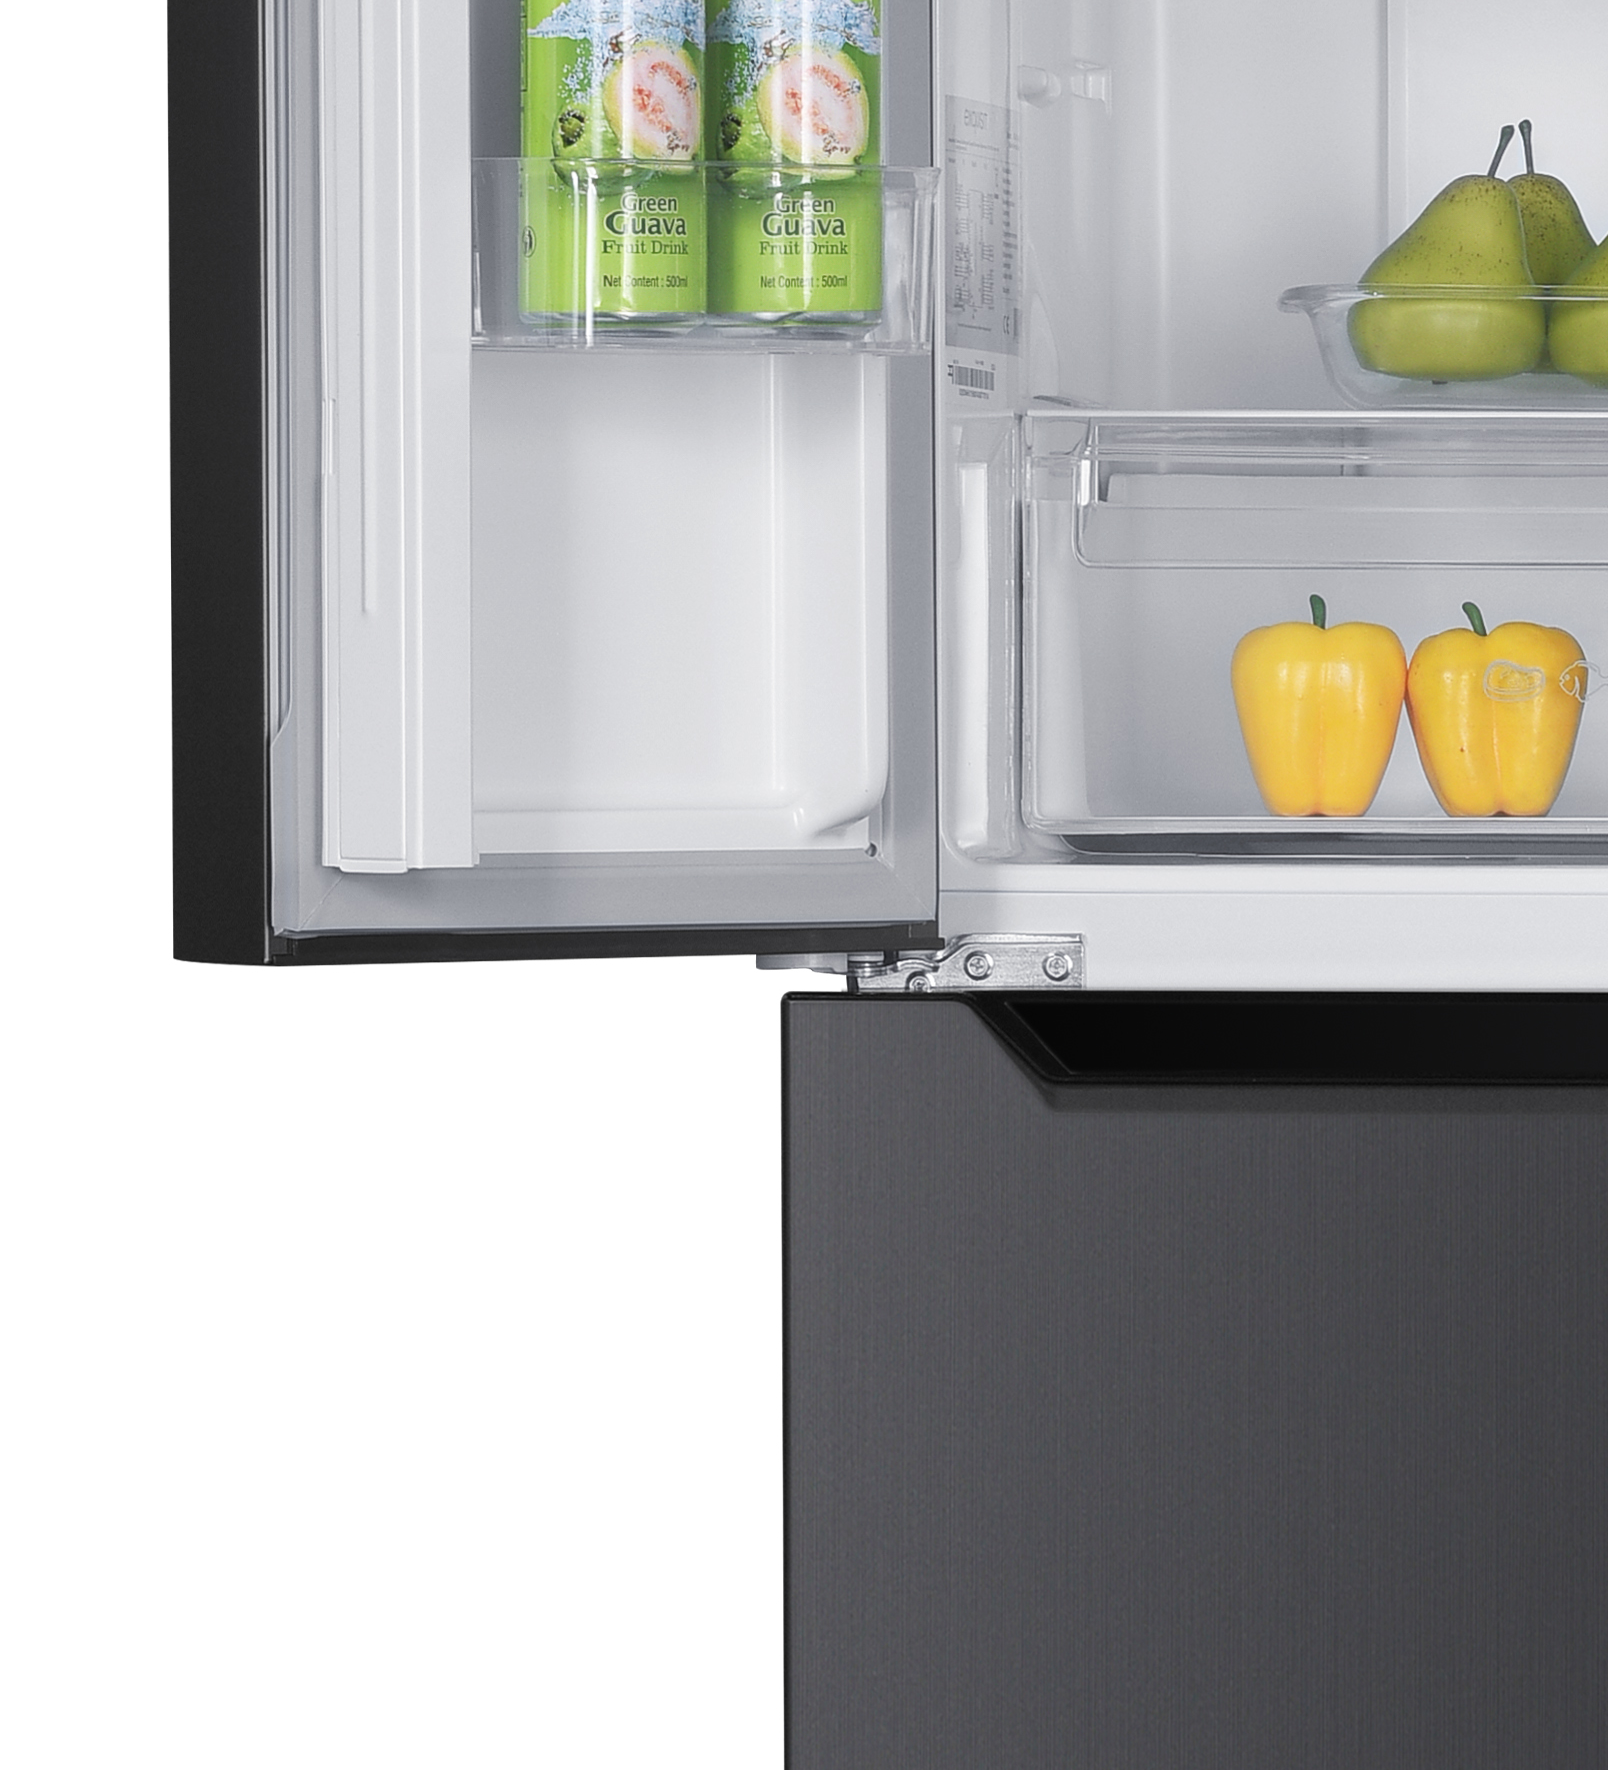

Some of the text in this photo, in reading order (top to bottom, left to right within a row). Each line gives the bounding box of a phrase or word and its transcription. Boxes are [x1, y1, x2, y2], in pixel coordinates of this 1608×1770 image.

[621, 192, 678, 212] Green
[775, 193, 835, 213] Green
[604, 210, 687, 236] Guava
[762, 212, 846, 237] Guava
[602, 240, 689, 254] Fruit Drink
[759, 241, 848, 255] Fruit Drink
[603, 275, 622, 287] Net
[625, 275, 659, 287] Content
[665, 275, 688, 287] 500ml
[760, 276, 776, 288] Net
[821, 275, 848, 287] 500ml
